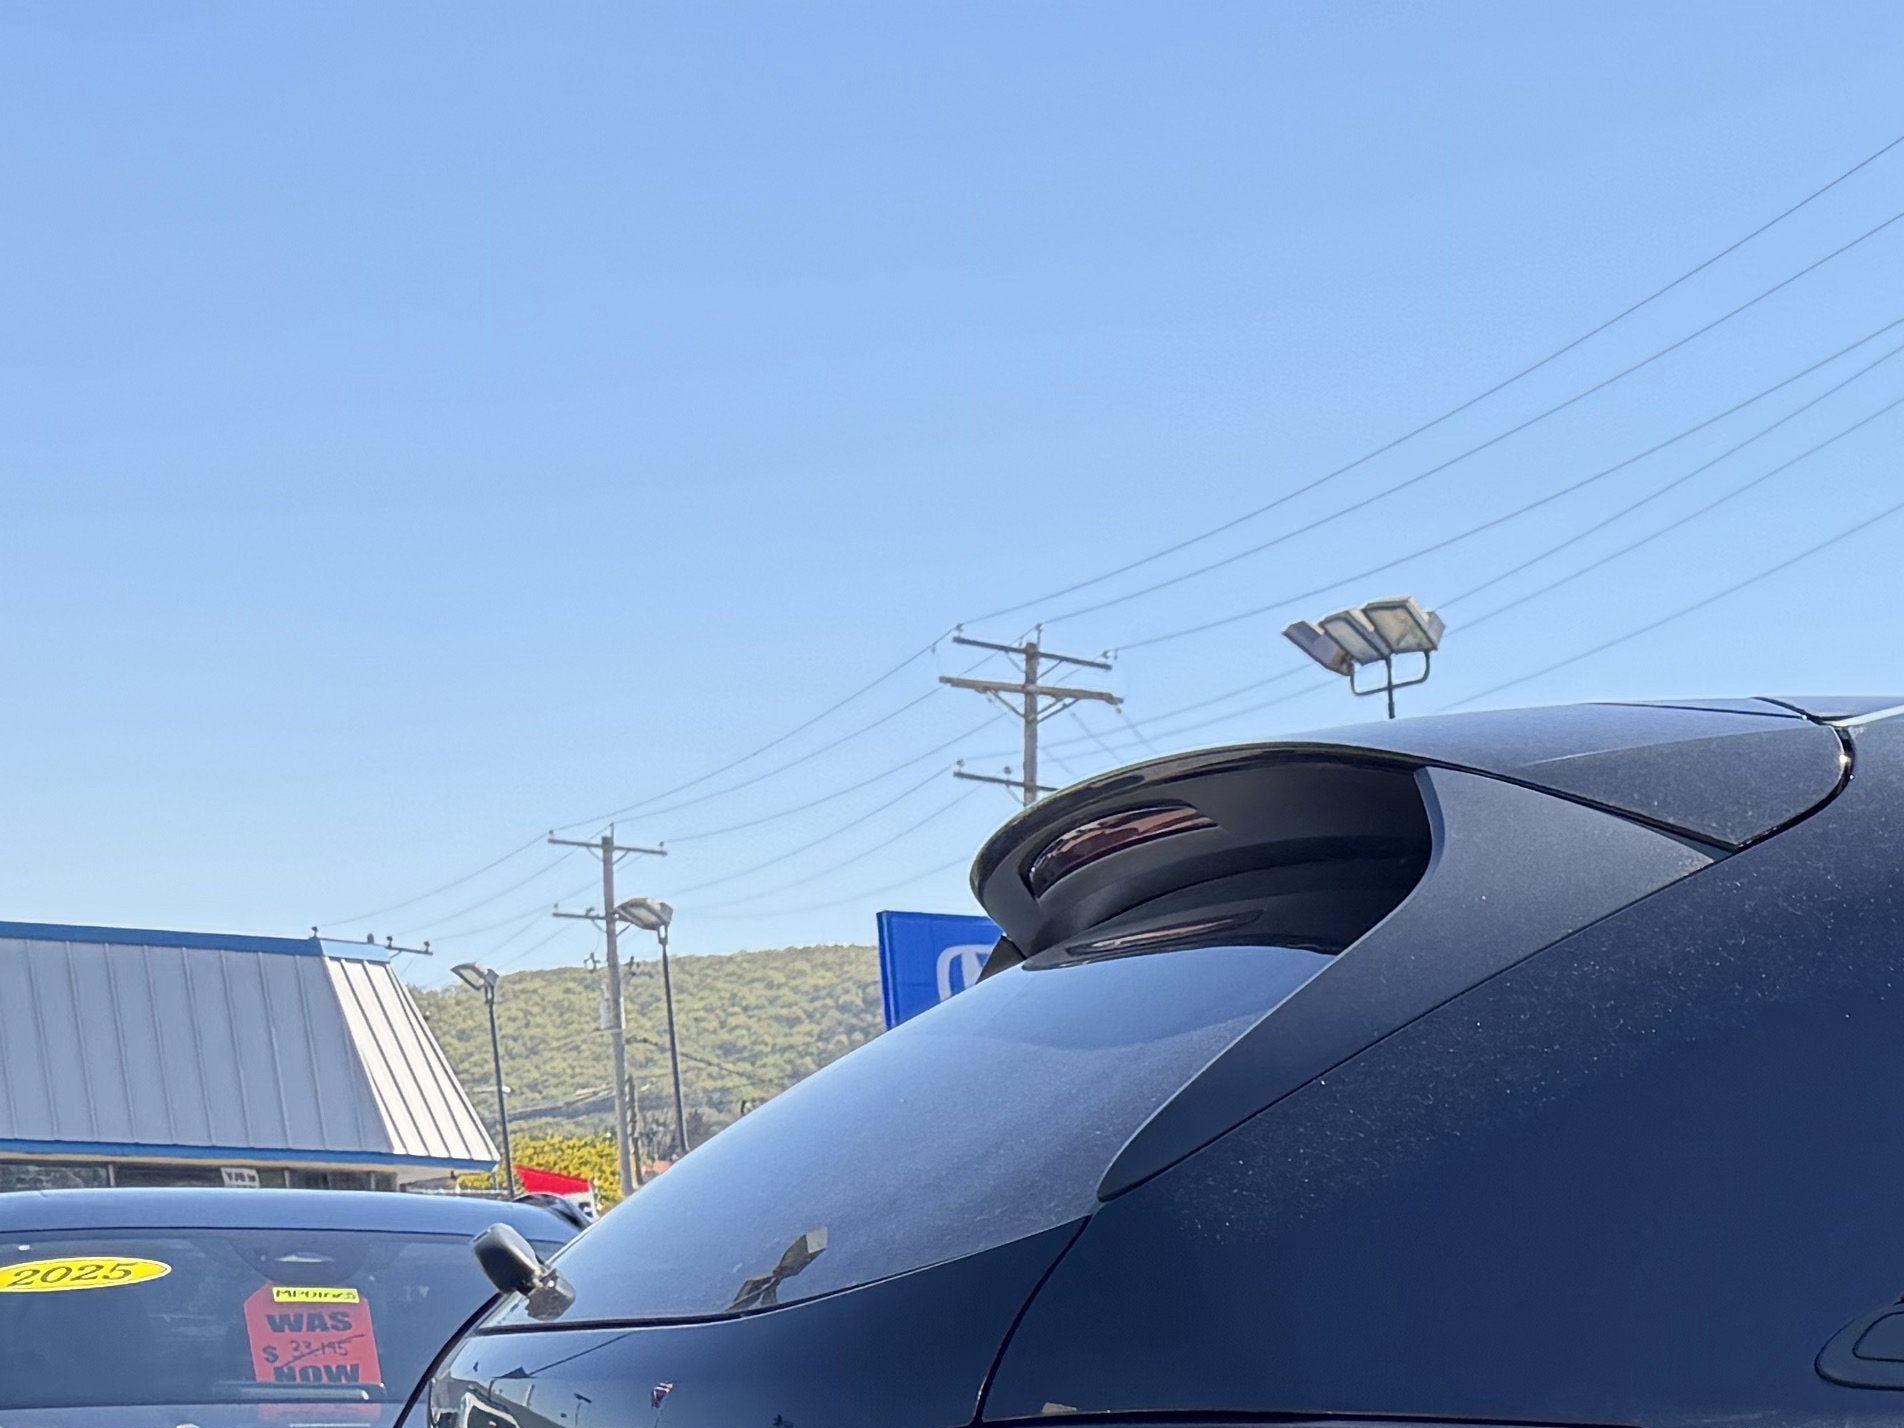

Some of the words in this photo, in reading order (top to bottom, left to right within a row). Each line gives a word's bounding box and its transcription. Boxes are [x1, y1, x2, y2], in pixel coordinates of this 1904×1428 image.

[6, 1262, 138, 1288] 2025
[266, 1311, 353, 1333] WAS
[273, 1362, 360, 1382] NOW
